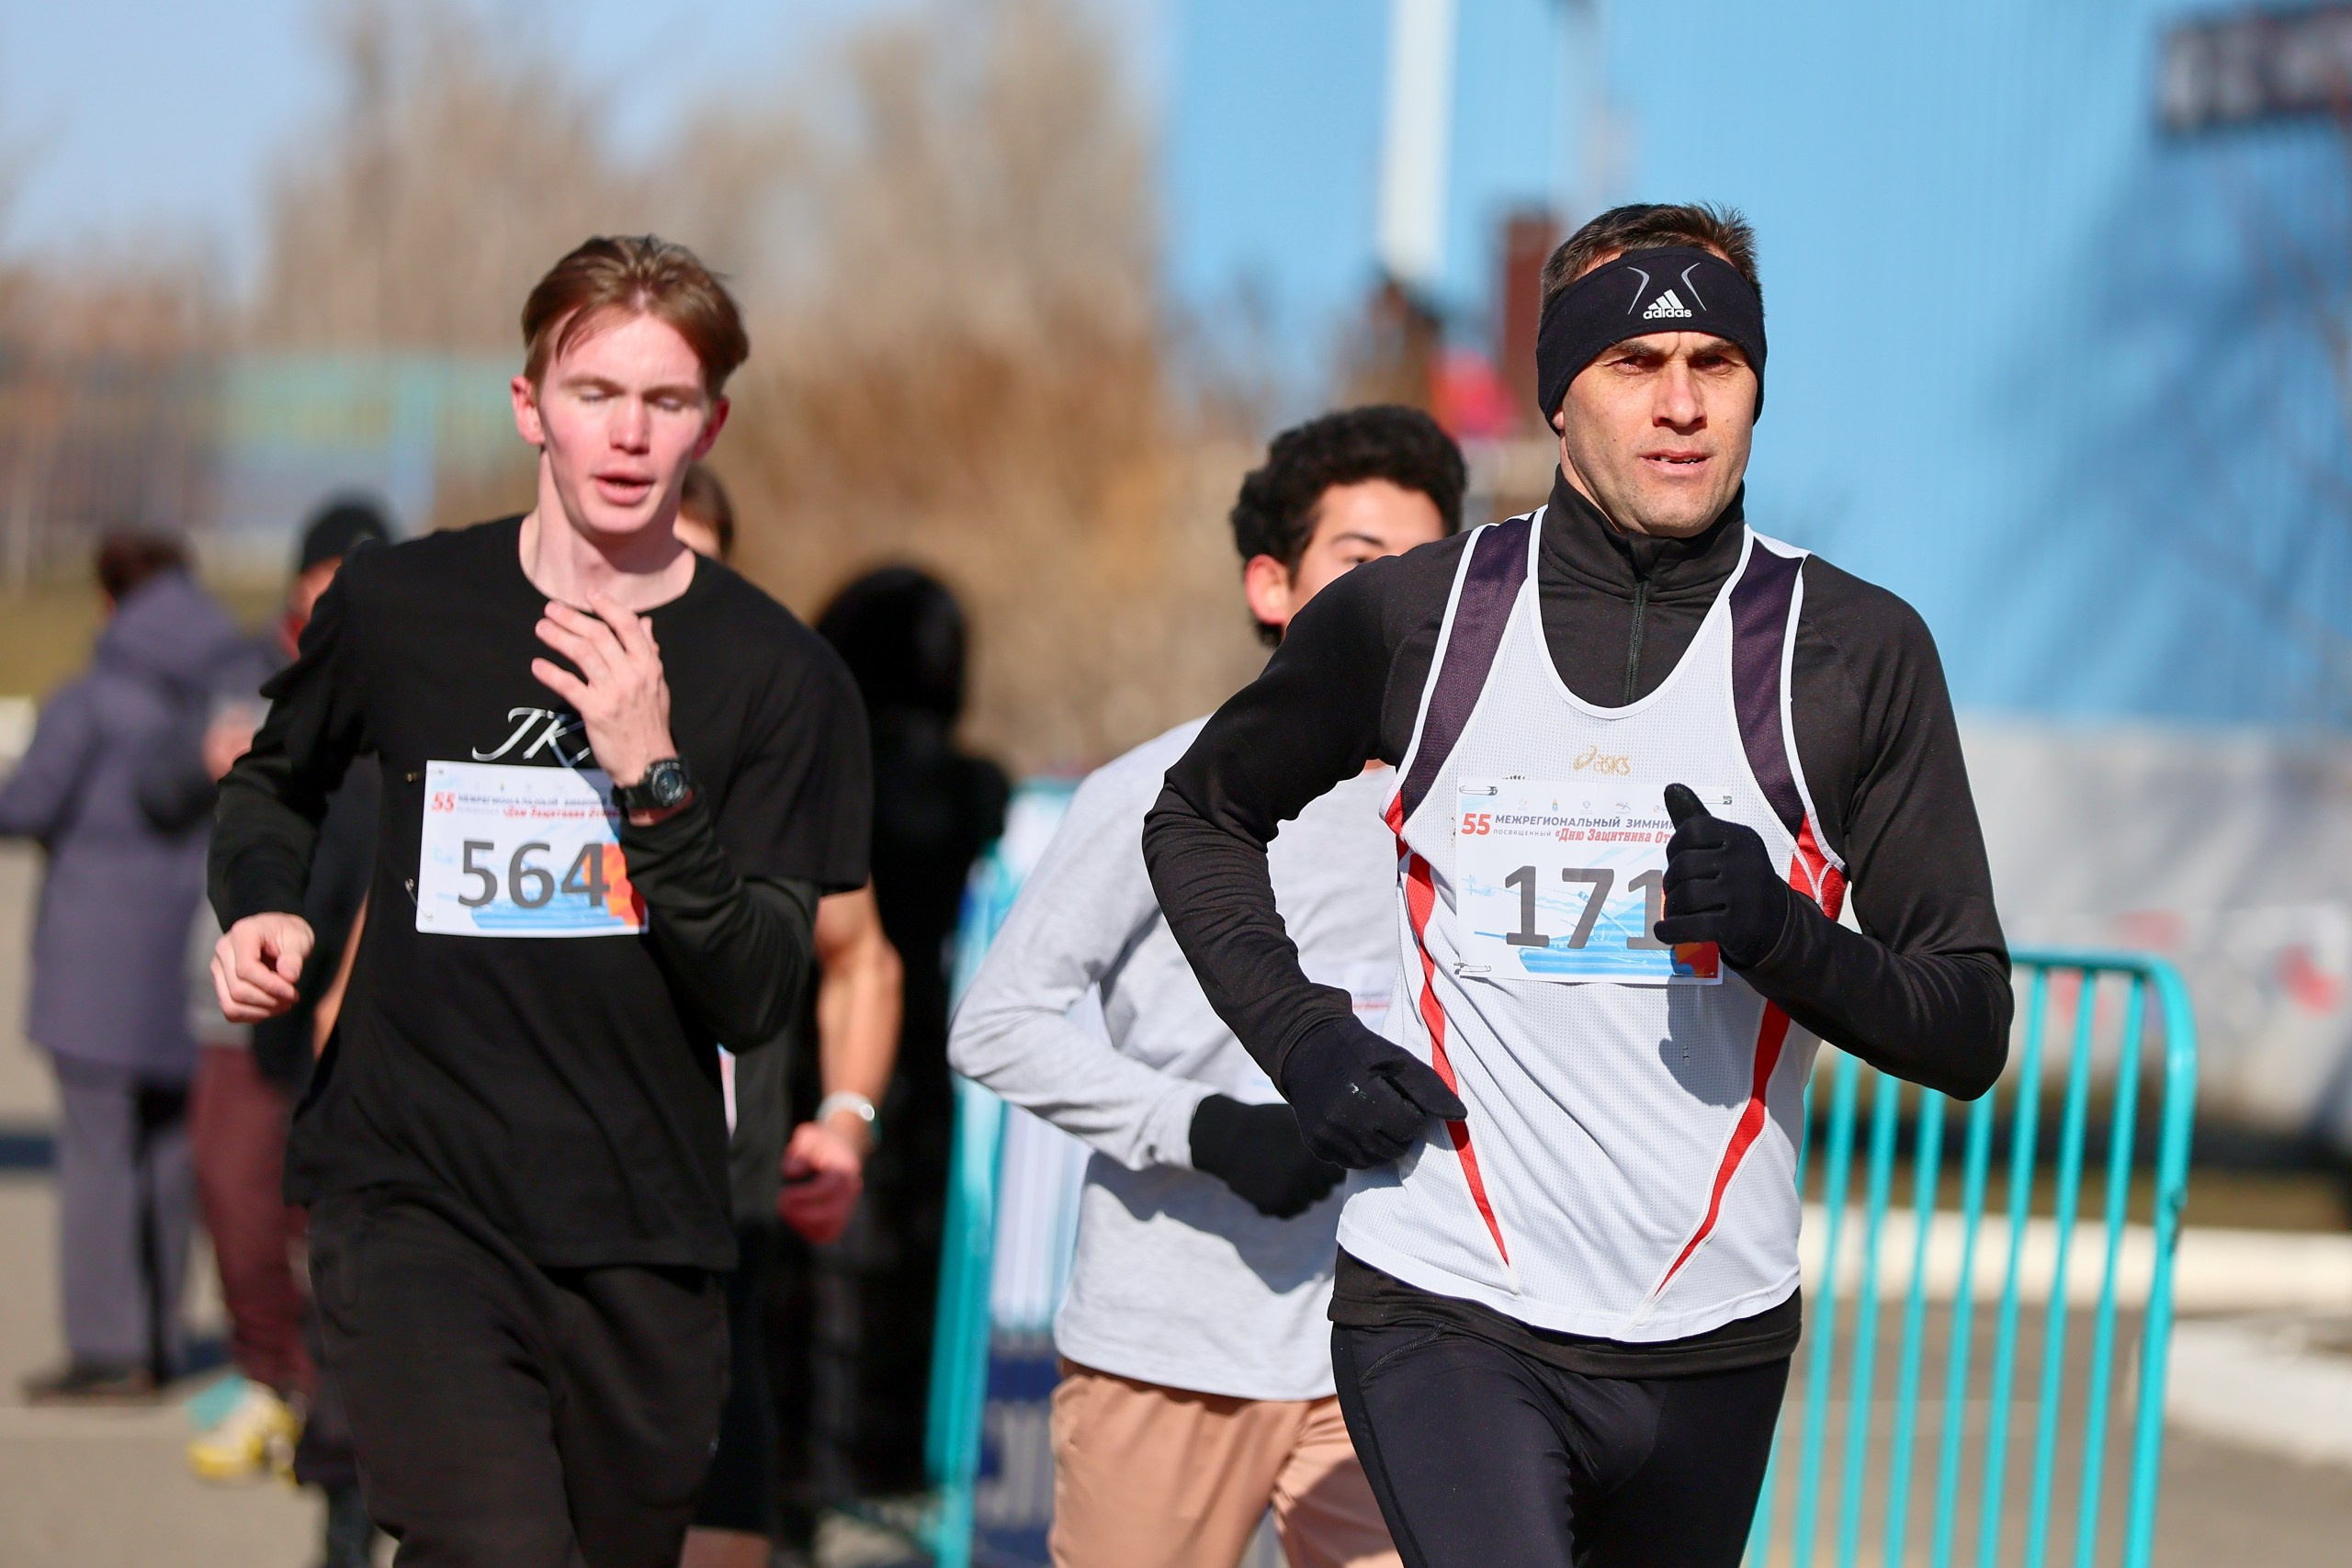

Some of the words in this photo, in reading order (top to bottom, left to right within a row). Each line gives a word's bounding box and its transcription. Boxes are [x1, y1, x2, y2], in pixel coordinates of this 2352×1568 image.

[1643, 307, 1692, 320] adidas
[432, 791, 457, 813] 55
[1462, 813, 1491, 835] 55
[1495, 815, 1621, 828] МЕЖРЕГИОНАЛЬНЫЙ
[1493, 829, 1552, 837] ПОСВЯЩЕННЫЙ
[1555, 828, 1585, 841] «Дню
[1587, 829, 1652, 842] Защитника
[458, 839, 610, 908] 564
[1505, 865, 1672, 950] 171
